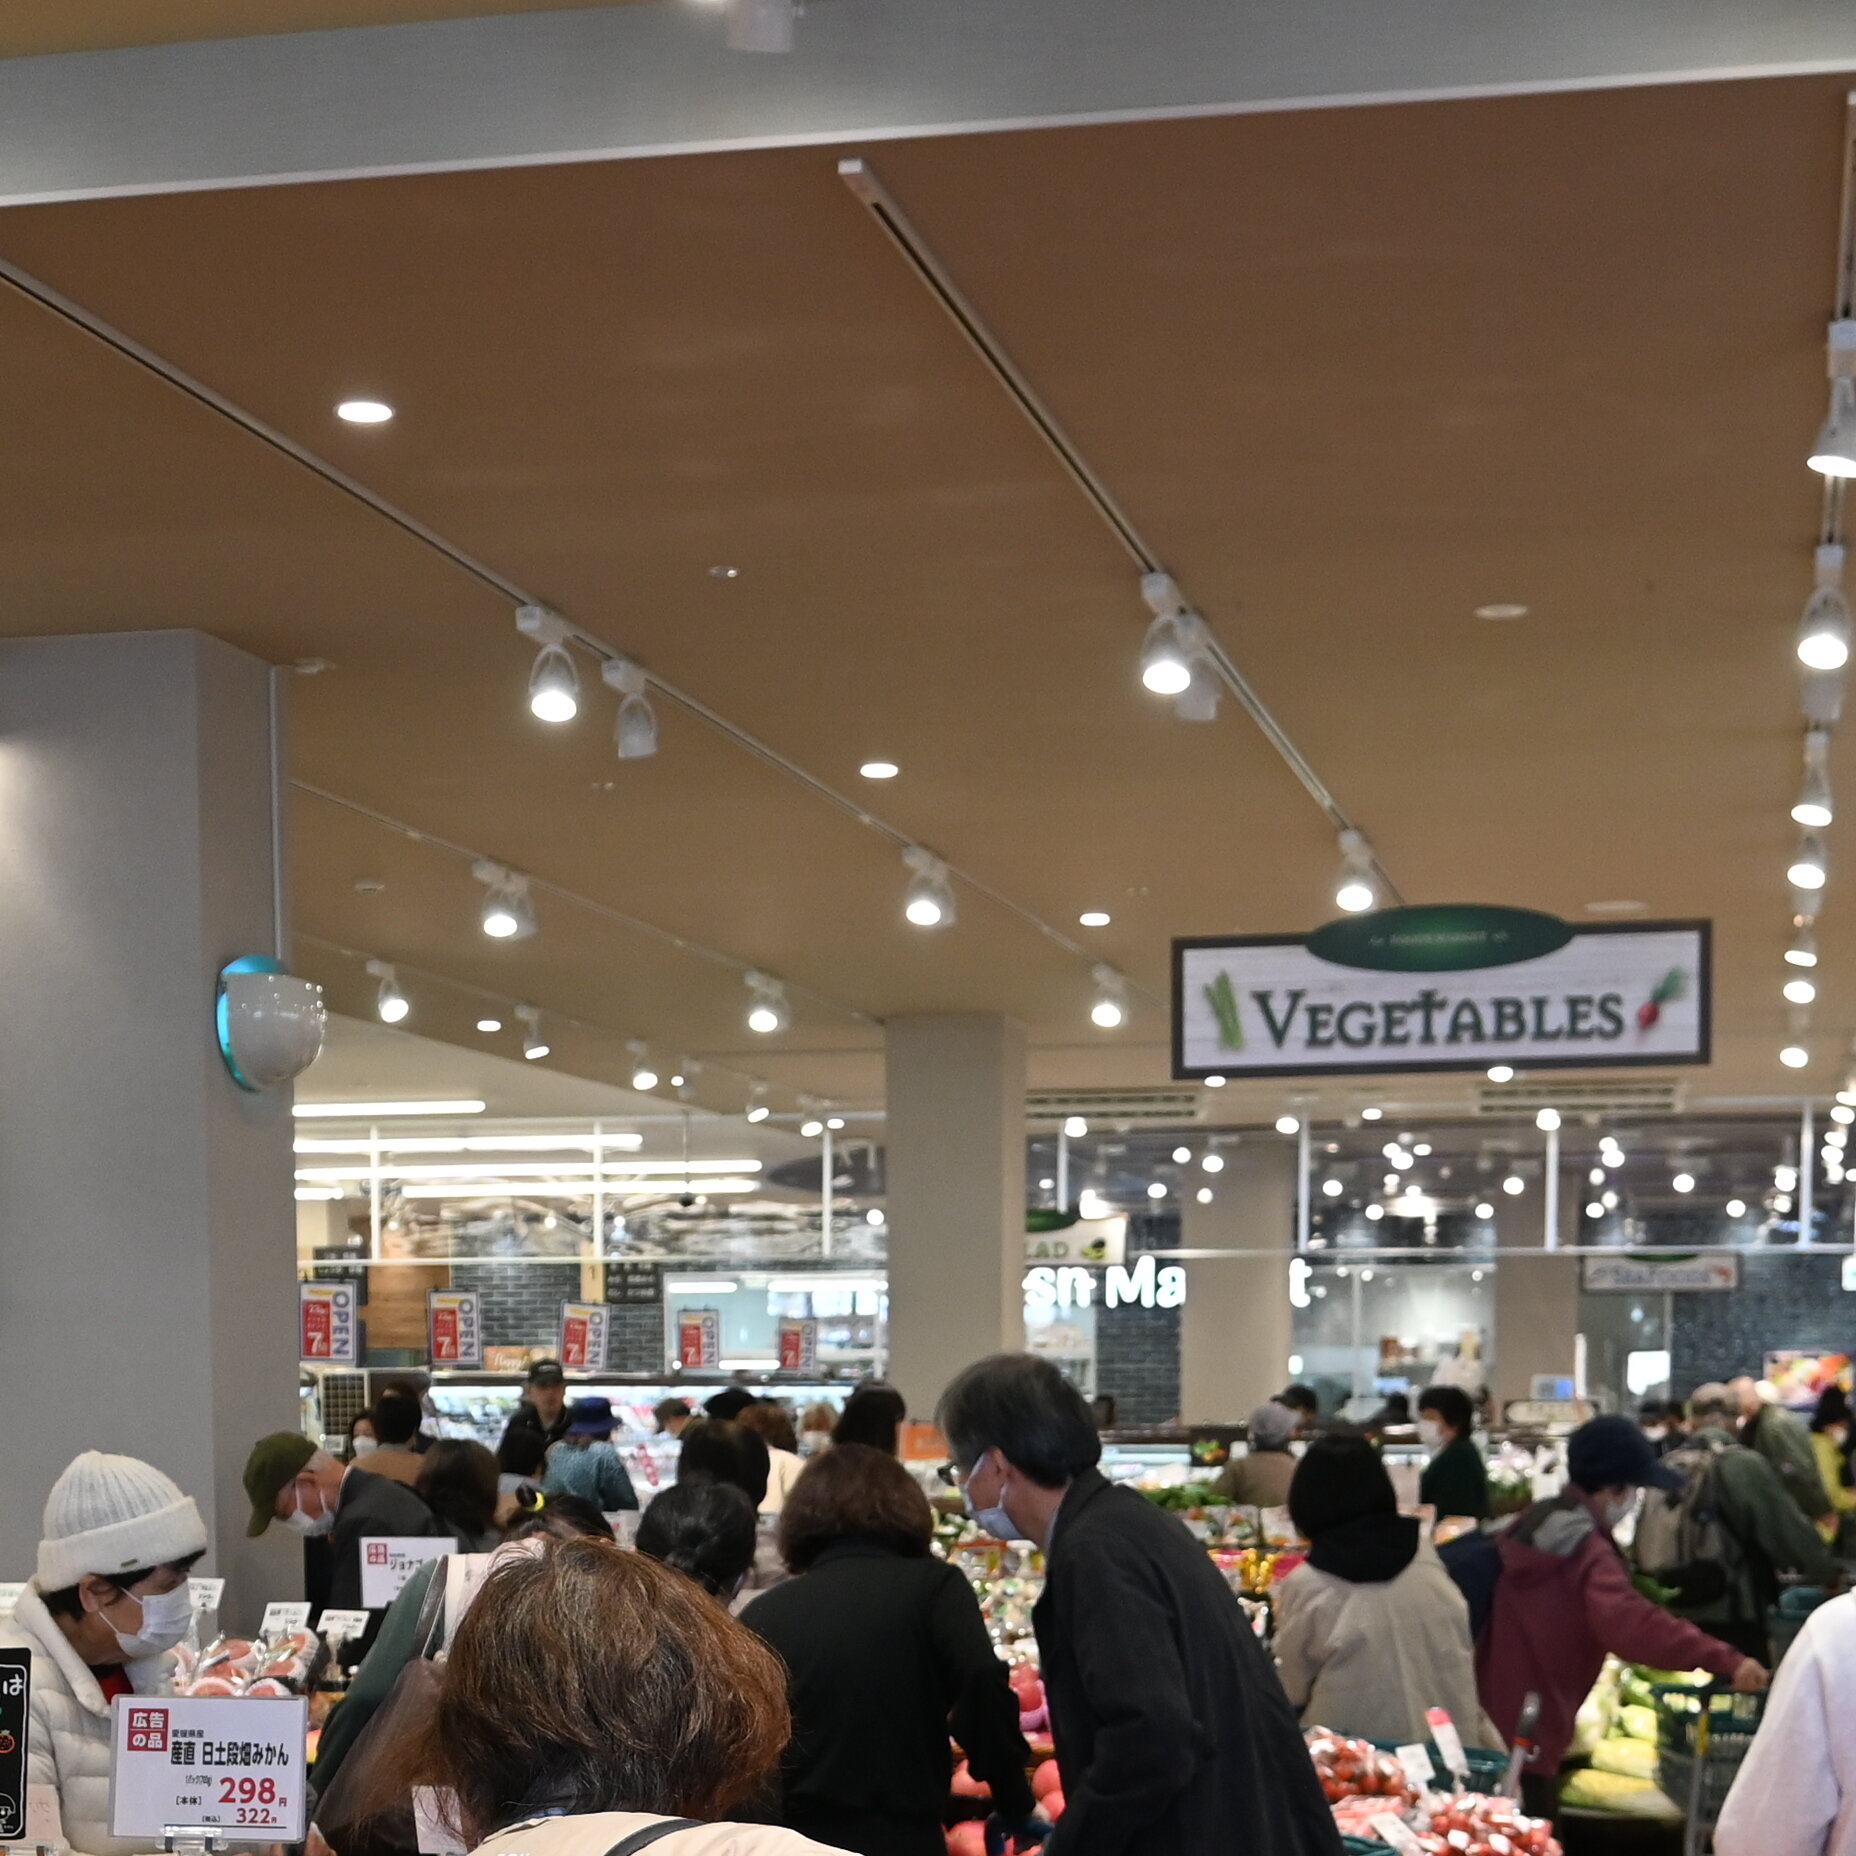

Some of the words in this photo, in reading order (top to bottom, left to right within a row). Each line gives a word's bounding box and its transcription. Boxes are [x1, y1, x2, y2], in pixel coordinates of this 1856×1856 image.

[133, 1712, 164, 1728] 広告
[132, 1732, 163, 1749] の品
[171, 1741, 195, 1765] 産直
[202, 1741, 289, 1766] 日土段畑みかん
[218, 1777, 287, 1807] 298円
[236, 1808, 277, 1824] 322円
